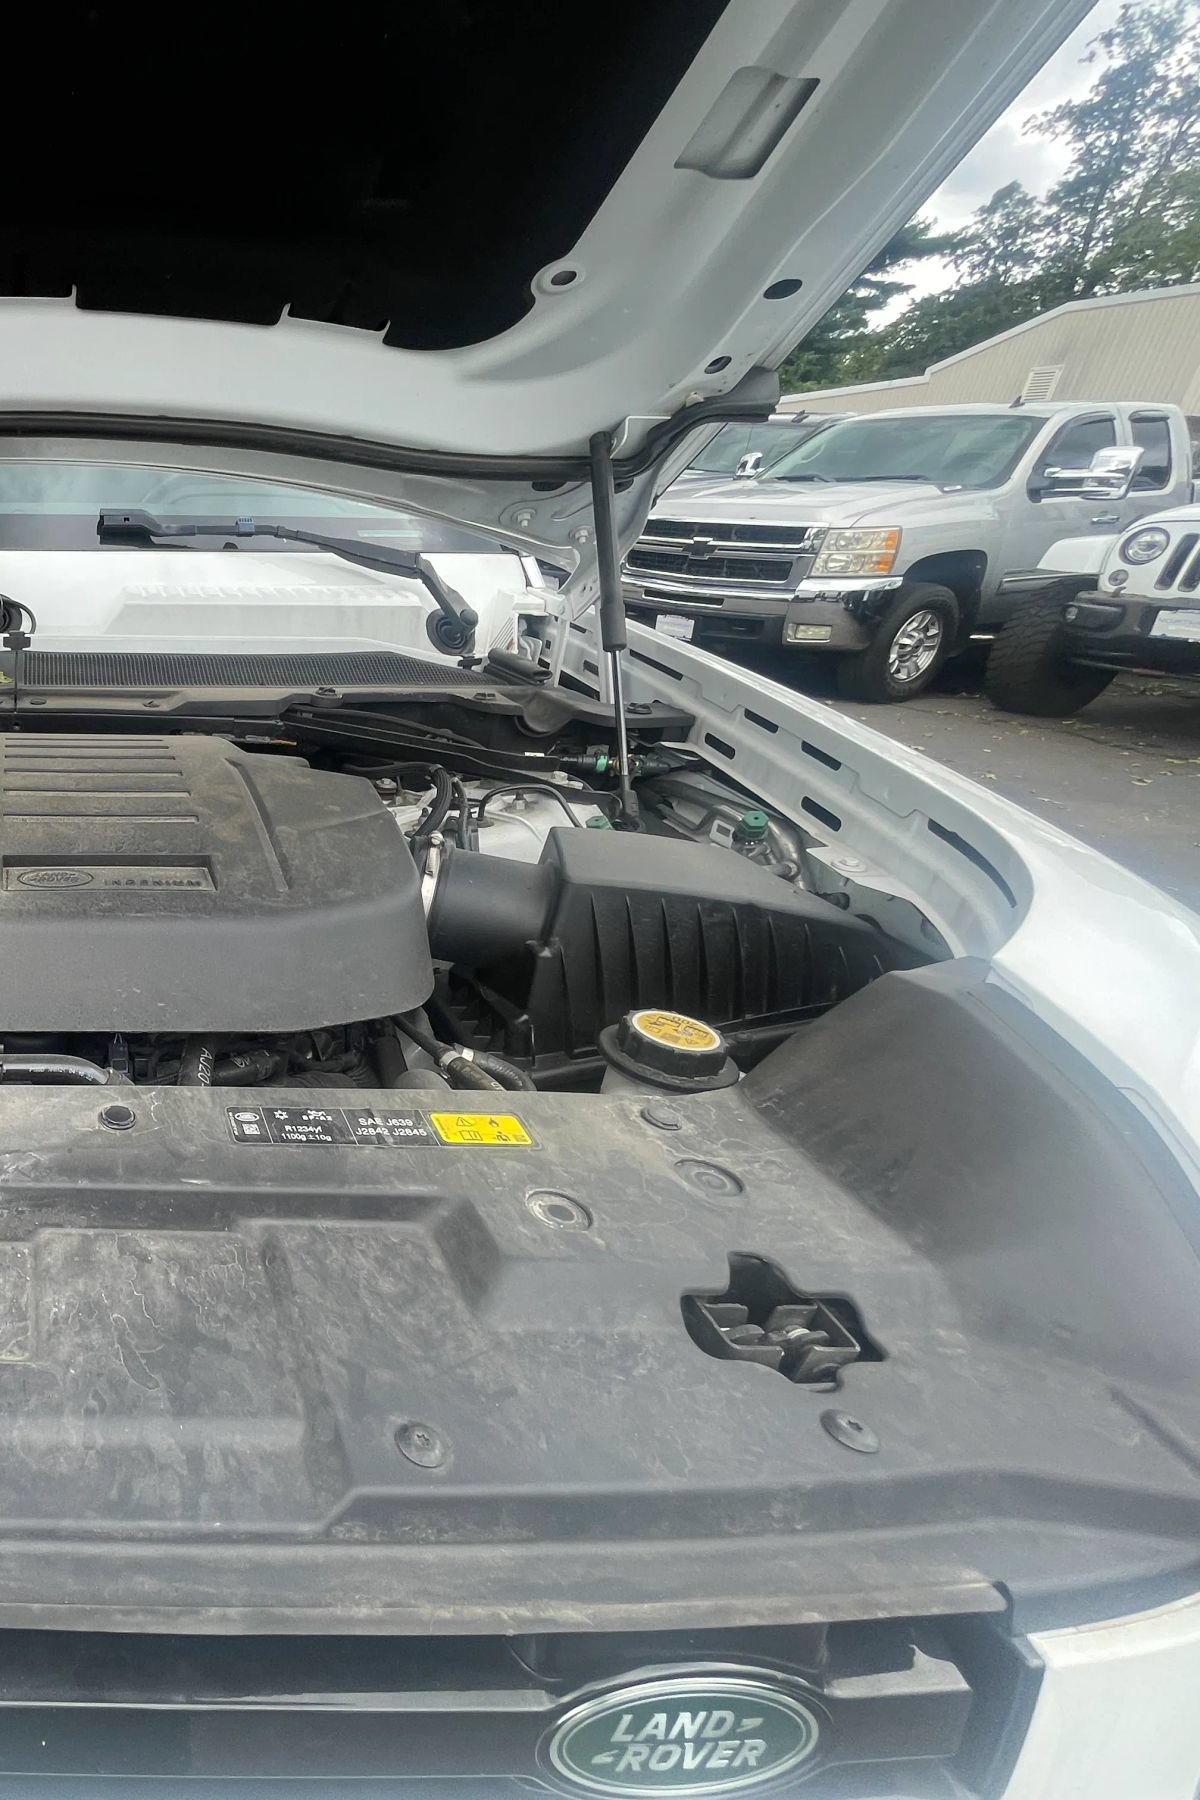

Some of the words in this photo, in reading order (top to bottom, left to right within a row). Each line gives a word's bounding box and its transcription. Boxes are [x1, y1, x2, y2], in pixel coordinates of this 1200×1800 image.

[104, 879, 203, 887] INGENIUM
[358, 1118, 382, 1126] SAE
[386, 1118, 413, 1126] J639
[284, 1125, 322, 1134] R1234yf
[281, 1133, 306, 1142] 1100g
[610, 1710, 735, 1742] LAND
[615, 1739, 767, 1772] ROVER
